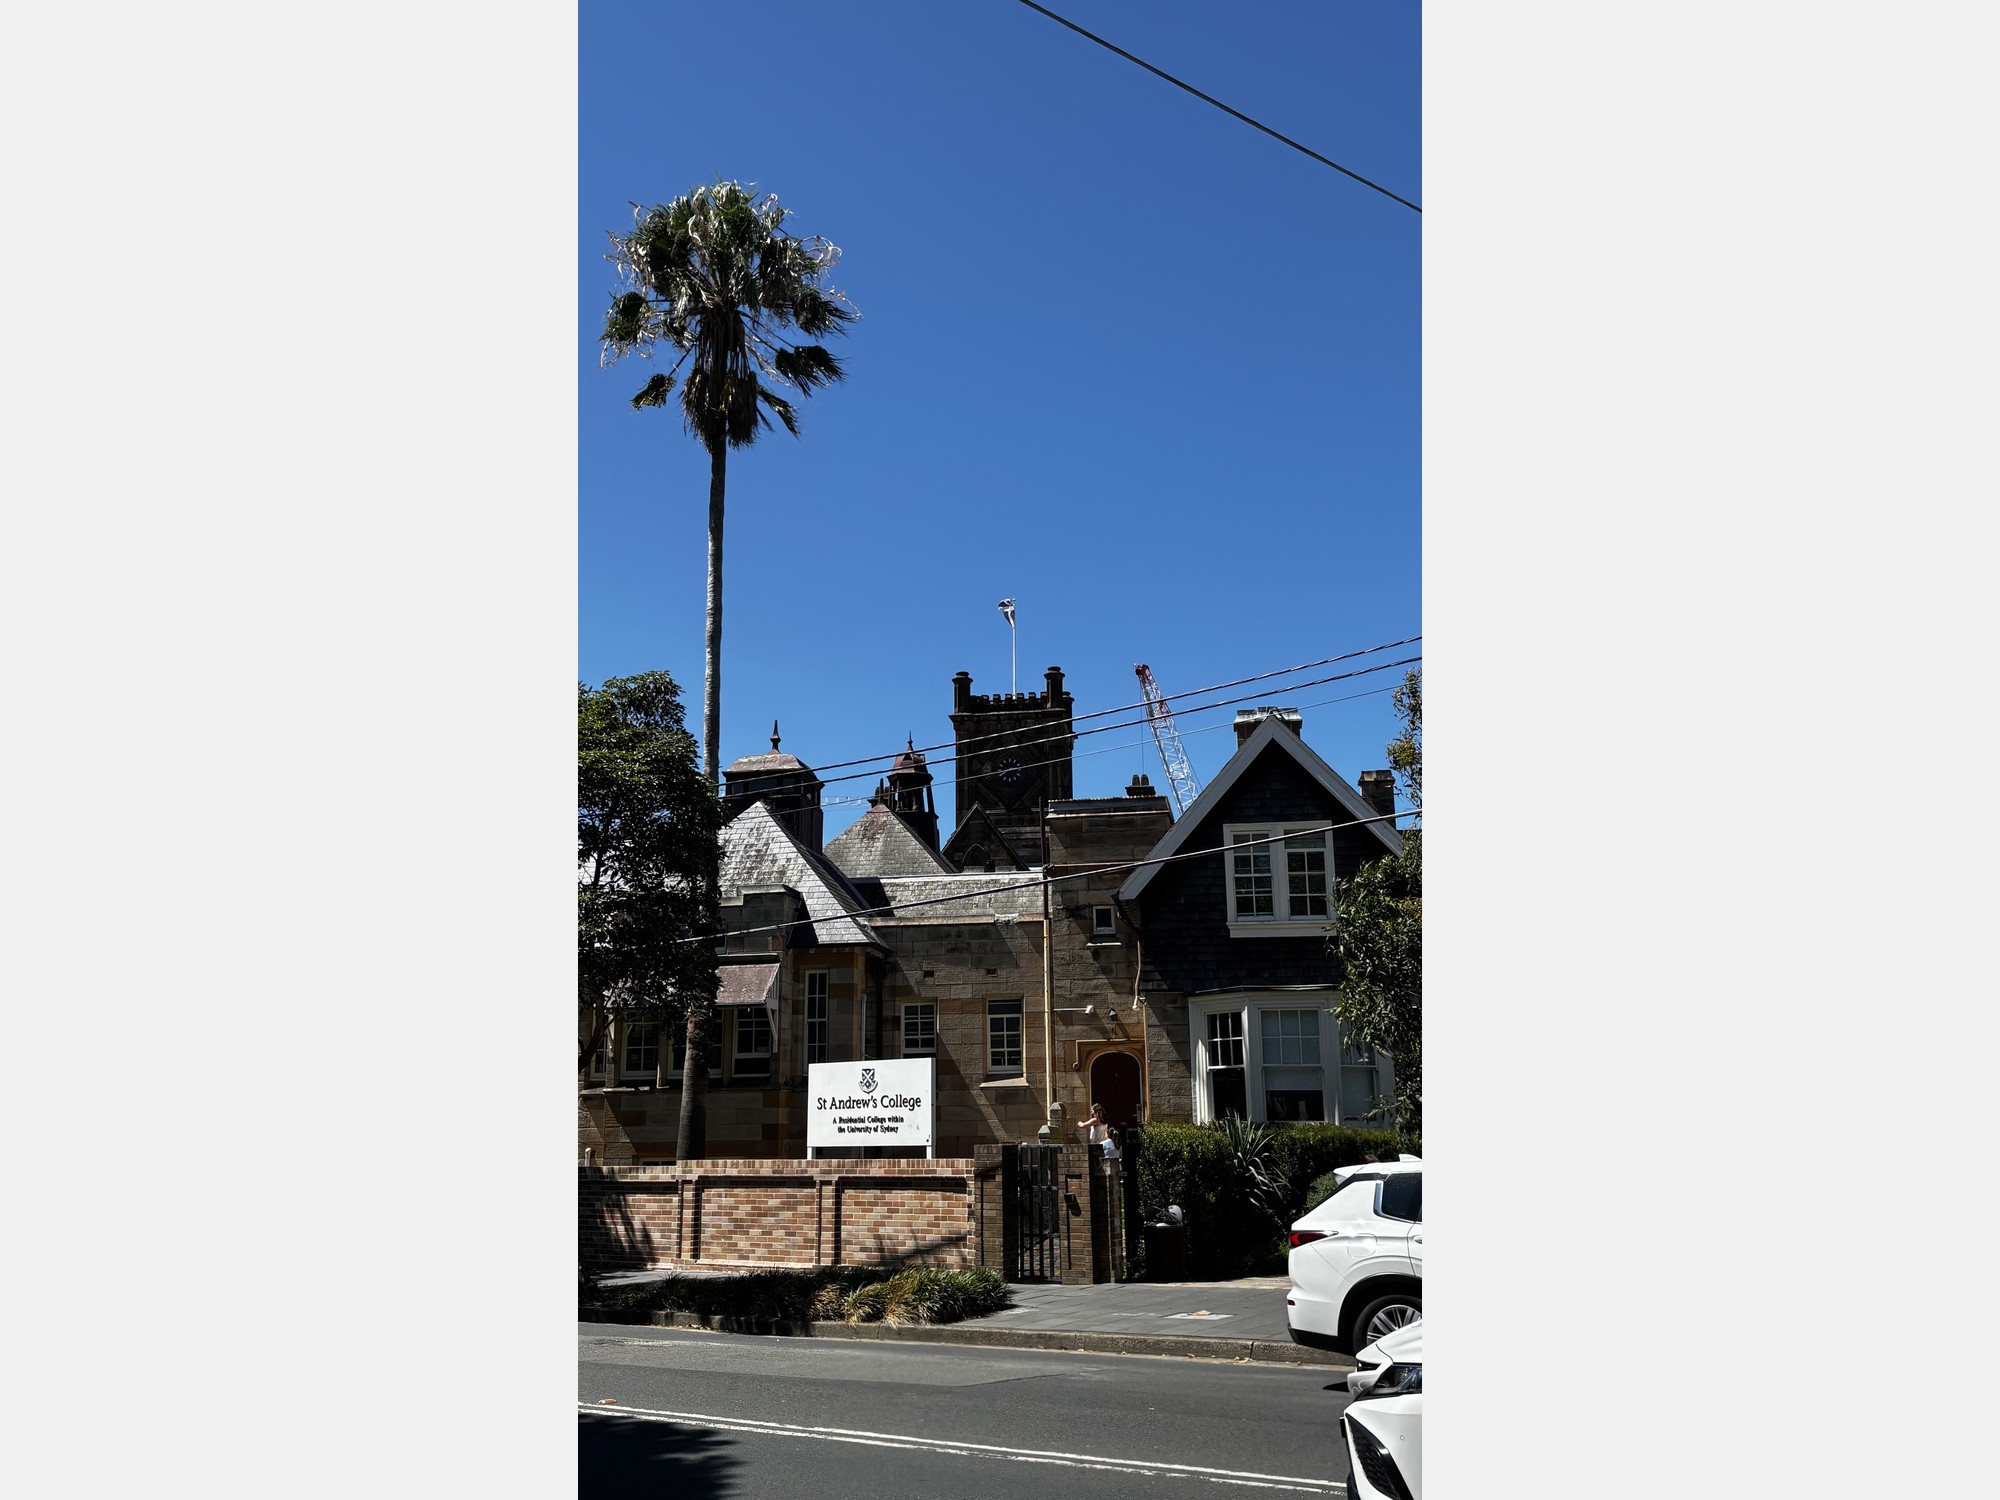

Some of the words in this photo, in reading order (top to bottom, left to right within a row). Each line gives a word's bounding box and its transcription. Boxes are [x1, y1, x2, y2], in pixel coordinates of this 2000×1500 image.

[817, 1097, 827, 1110] St
[830, 1095, 878, 1110] Andrew's
[881, 1094, 922, 1111] College
[839, 1116, 866, 1124] Residential
[867, 1116, 886, 1125] College
[888, 1115, 904, 1123] within
[847, 1125, 872, 1134] University
[873, 1125, 879, 1133] of
[880, 1125, 899, 1134] Sydney
